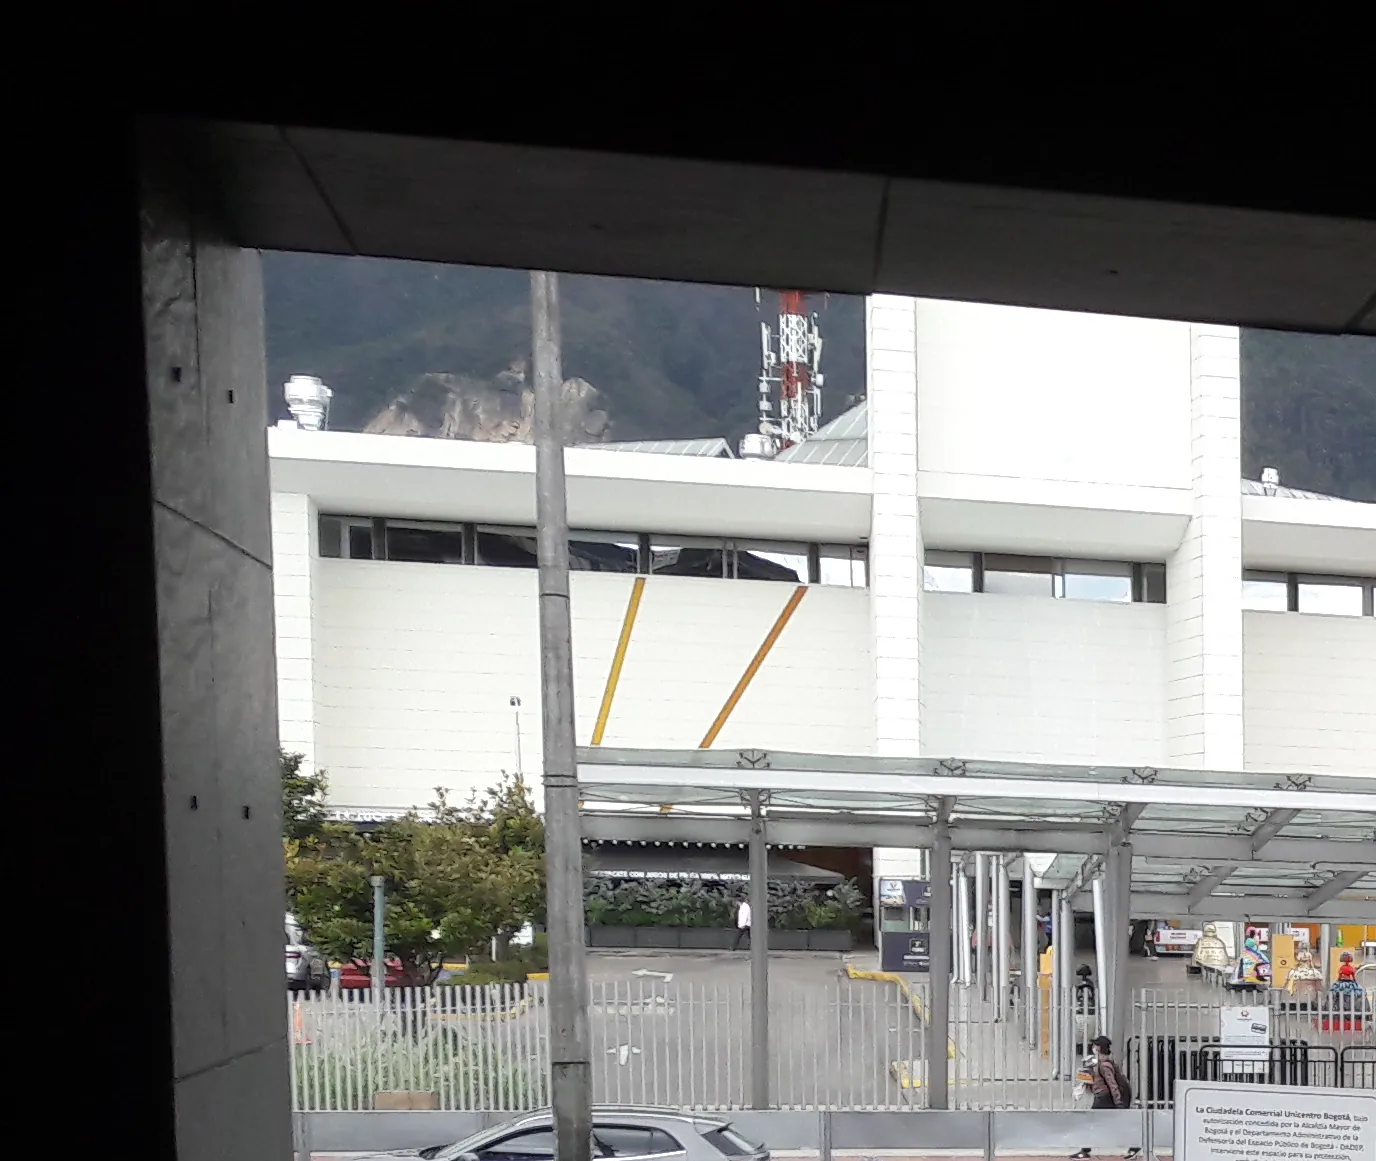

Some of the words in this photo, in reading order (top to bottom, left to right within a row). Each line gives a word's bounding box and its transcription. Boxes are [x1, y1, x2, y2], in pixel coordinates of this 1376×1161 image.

[1206, 1106, 1243, 1115] Ciudadela
[1245, 1108, 1283, 1117] Comercial
[1284, 1111, 1322, 1119] Unicentro
